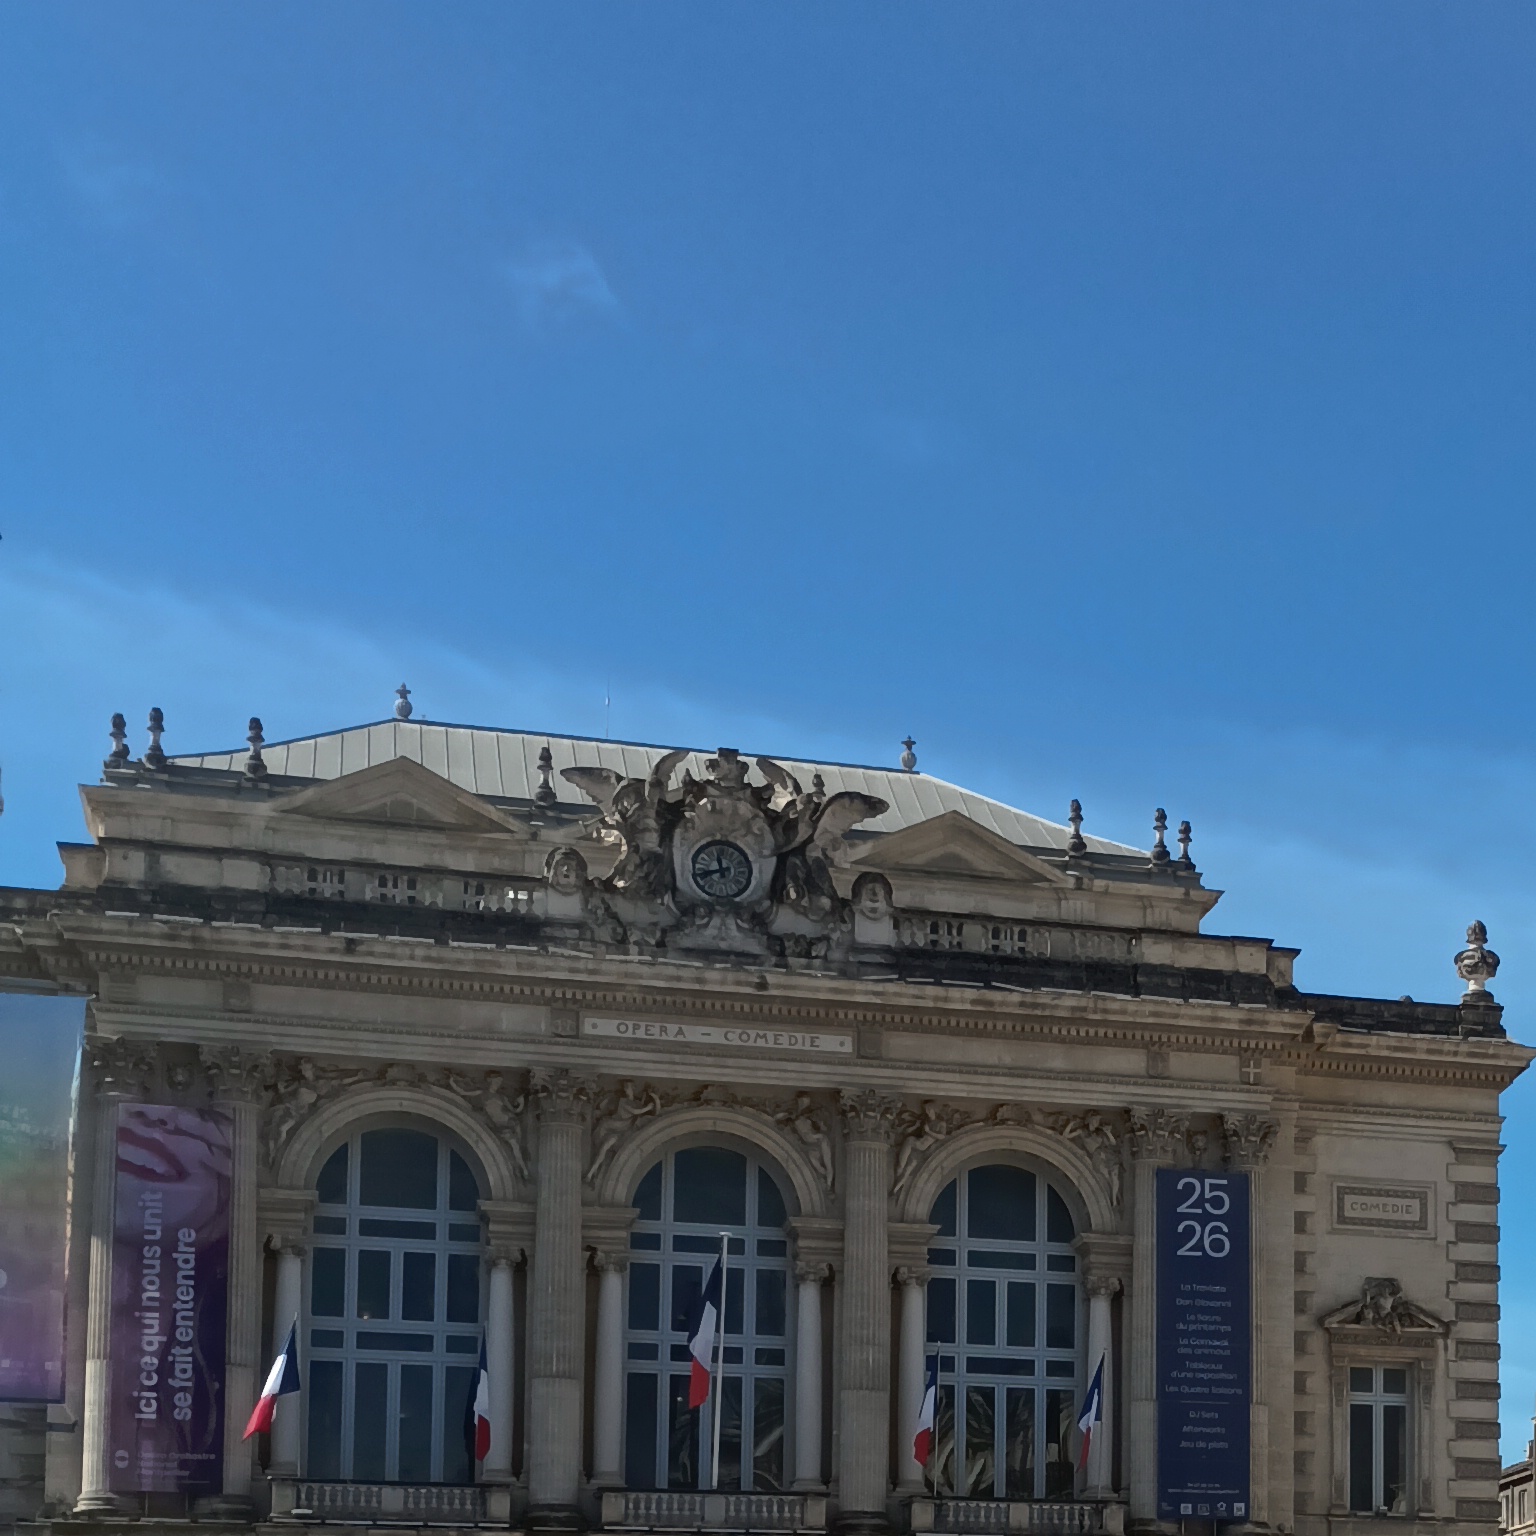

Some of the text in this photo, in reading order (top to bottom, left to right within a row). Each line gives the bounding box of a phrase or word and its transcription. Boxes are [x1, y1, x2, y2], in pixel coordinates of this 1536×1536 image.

[616, 1022, 687, 1039] OPERA
[723, 1030, 821, 1049] COMEDIE
[1177, 1177, 1230, 1215] 25
[1350, 1201, 1413, 1215] COMEDIE
[1177, 1220, 1231, 1258] 26
[132, 1190, 167, 1420] Ici ce qui nous unit
[167, 1227, 197, 1421] se fait entendre
